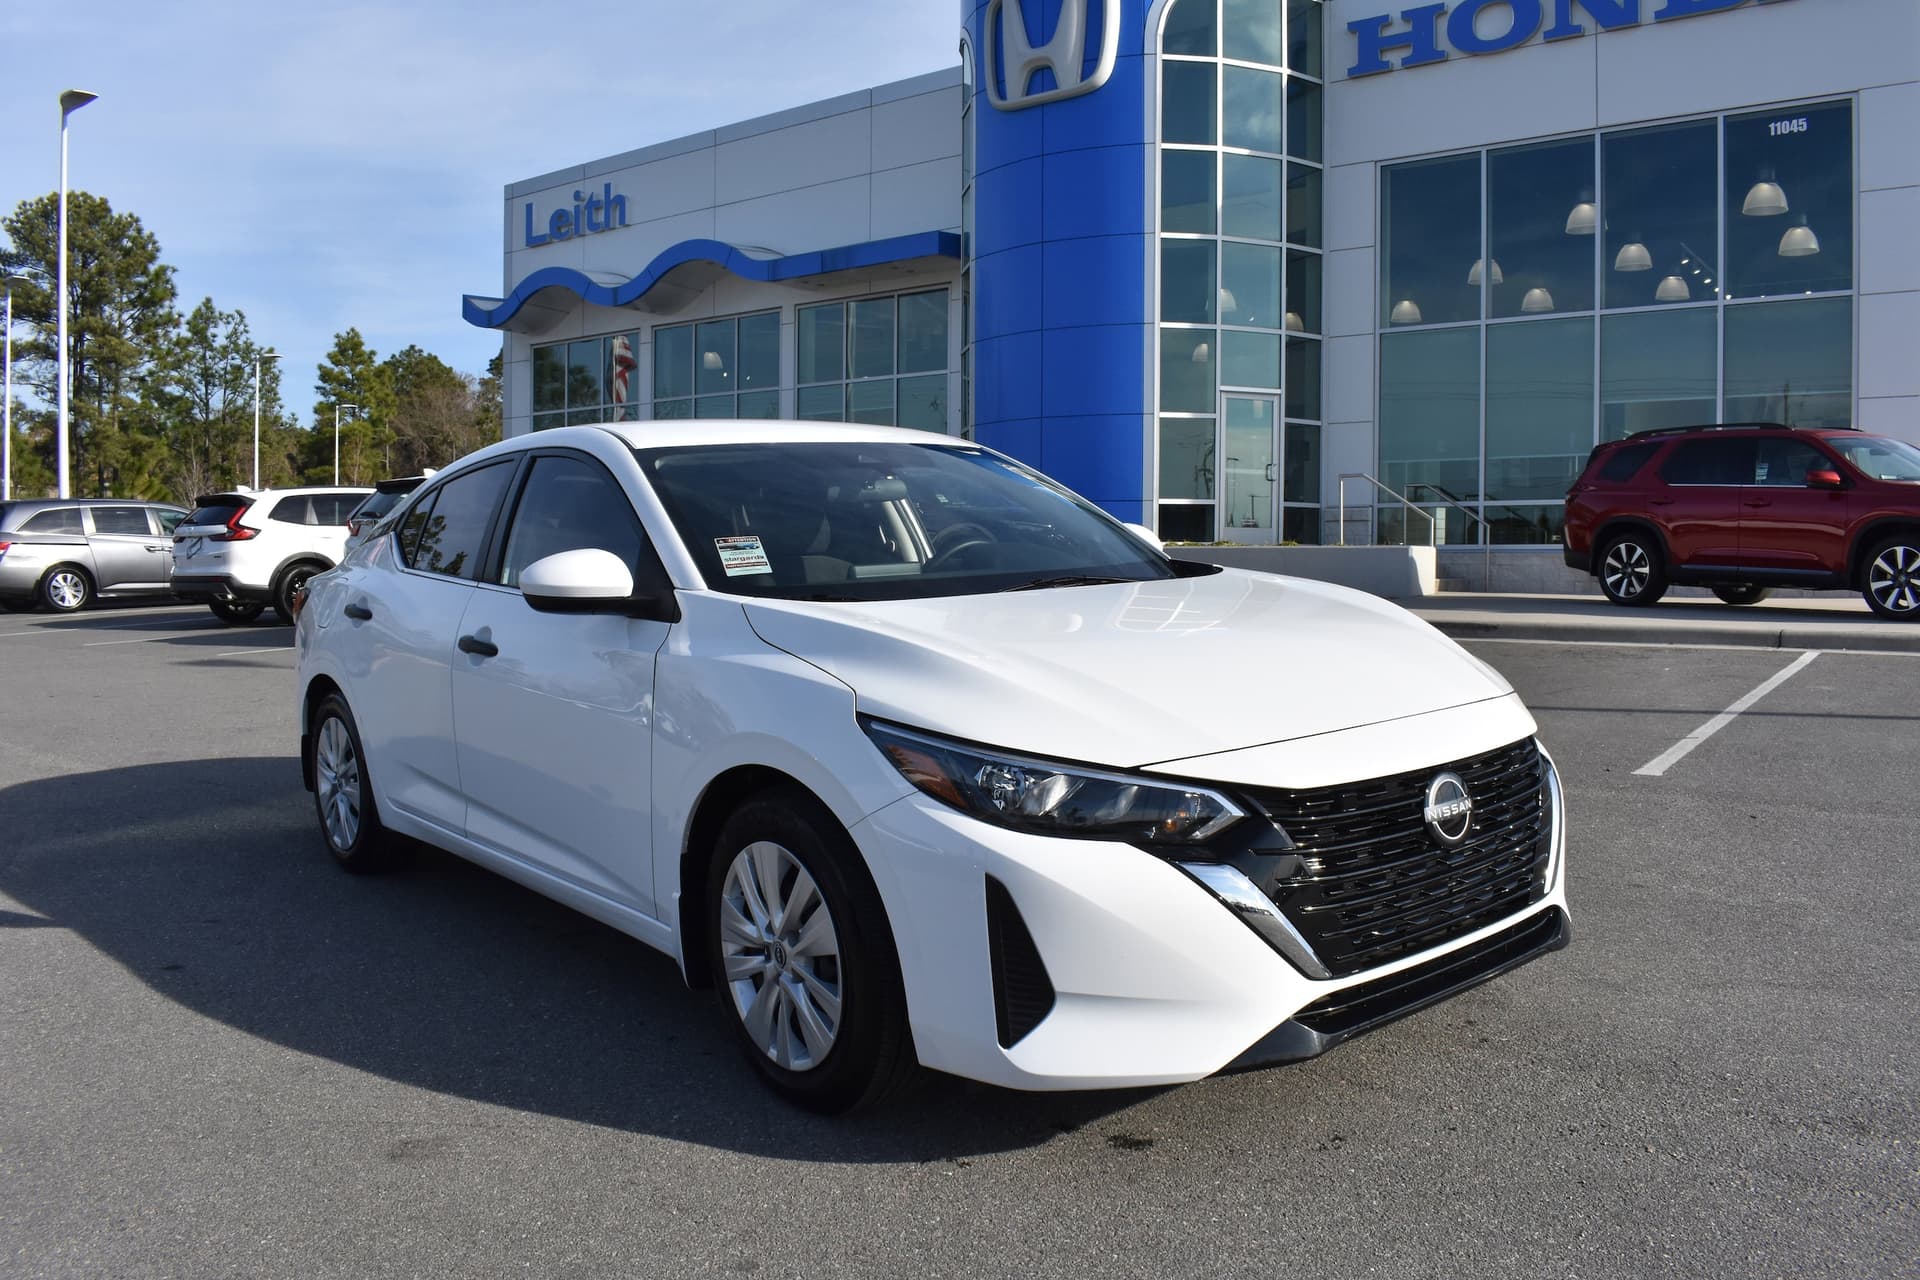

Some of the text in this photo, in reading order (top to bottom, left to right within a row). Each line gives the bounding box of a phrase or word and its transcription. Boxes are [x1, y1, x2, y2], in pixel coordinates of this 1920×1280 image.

[1346, 0, 1792, 78] HON
[1768, 117, 1808, 136] 11045
[525, 182, 626, 247] Leith
[1427, 798, 1472, 820] NISSAN
